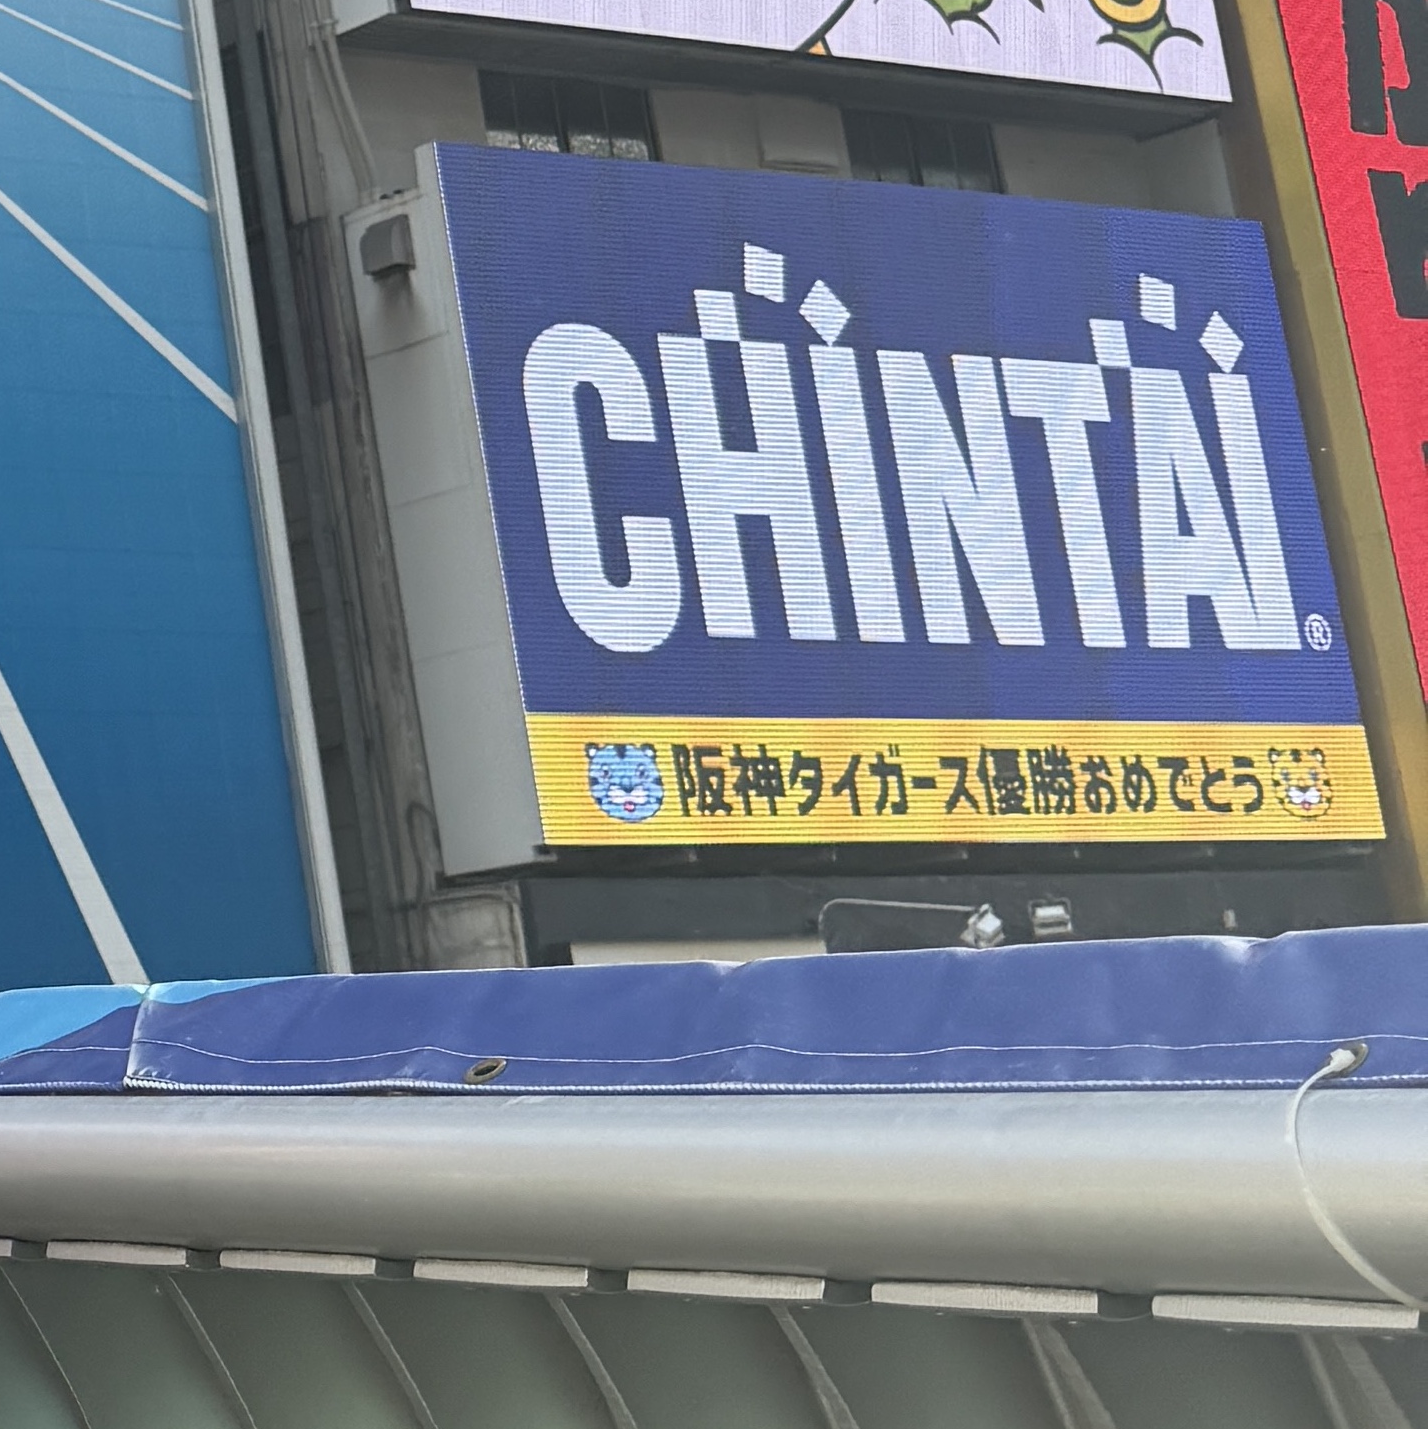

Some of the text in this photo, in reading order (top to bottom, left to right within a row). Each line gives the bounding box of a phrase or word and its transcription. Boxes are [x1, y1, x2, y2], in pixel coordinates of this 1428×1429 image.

[523, 241, 1301, 653] CHINTAI
[672, 743, 1264, 816] 阪神タイガース優勝おめでとう
